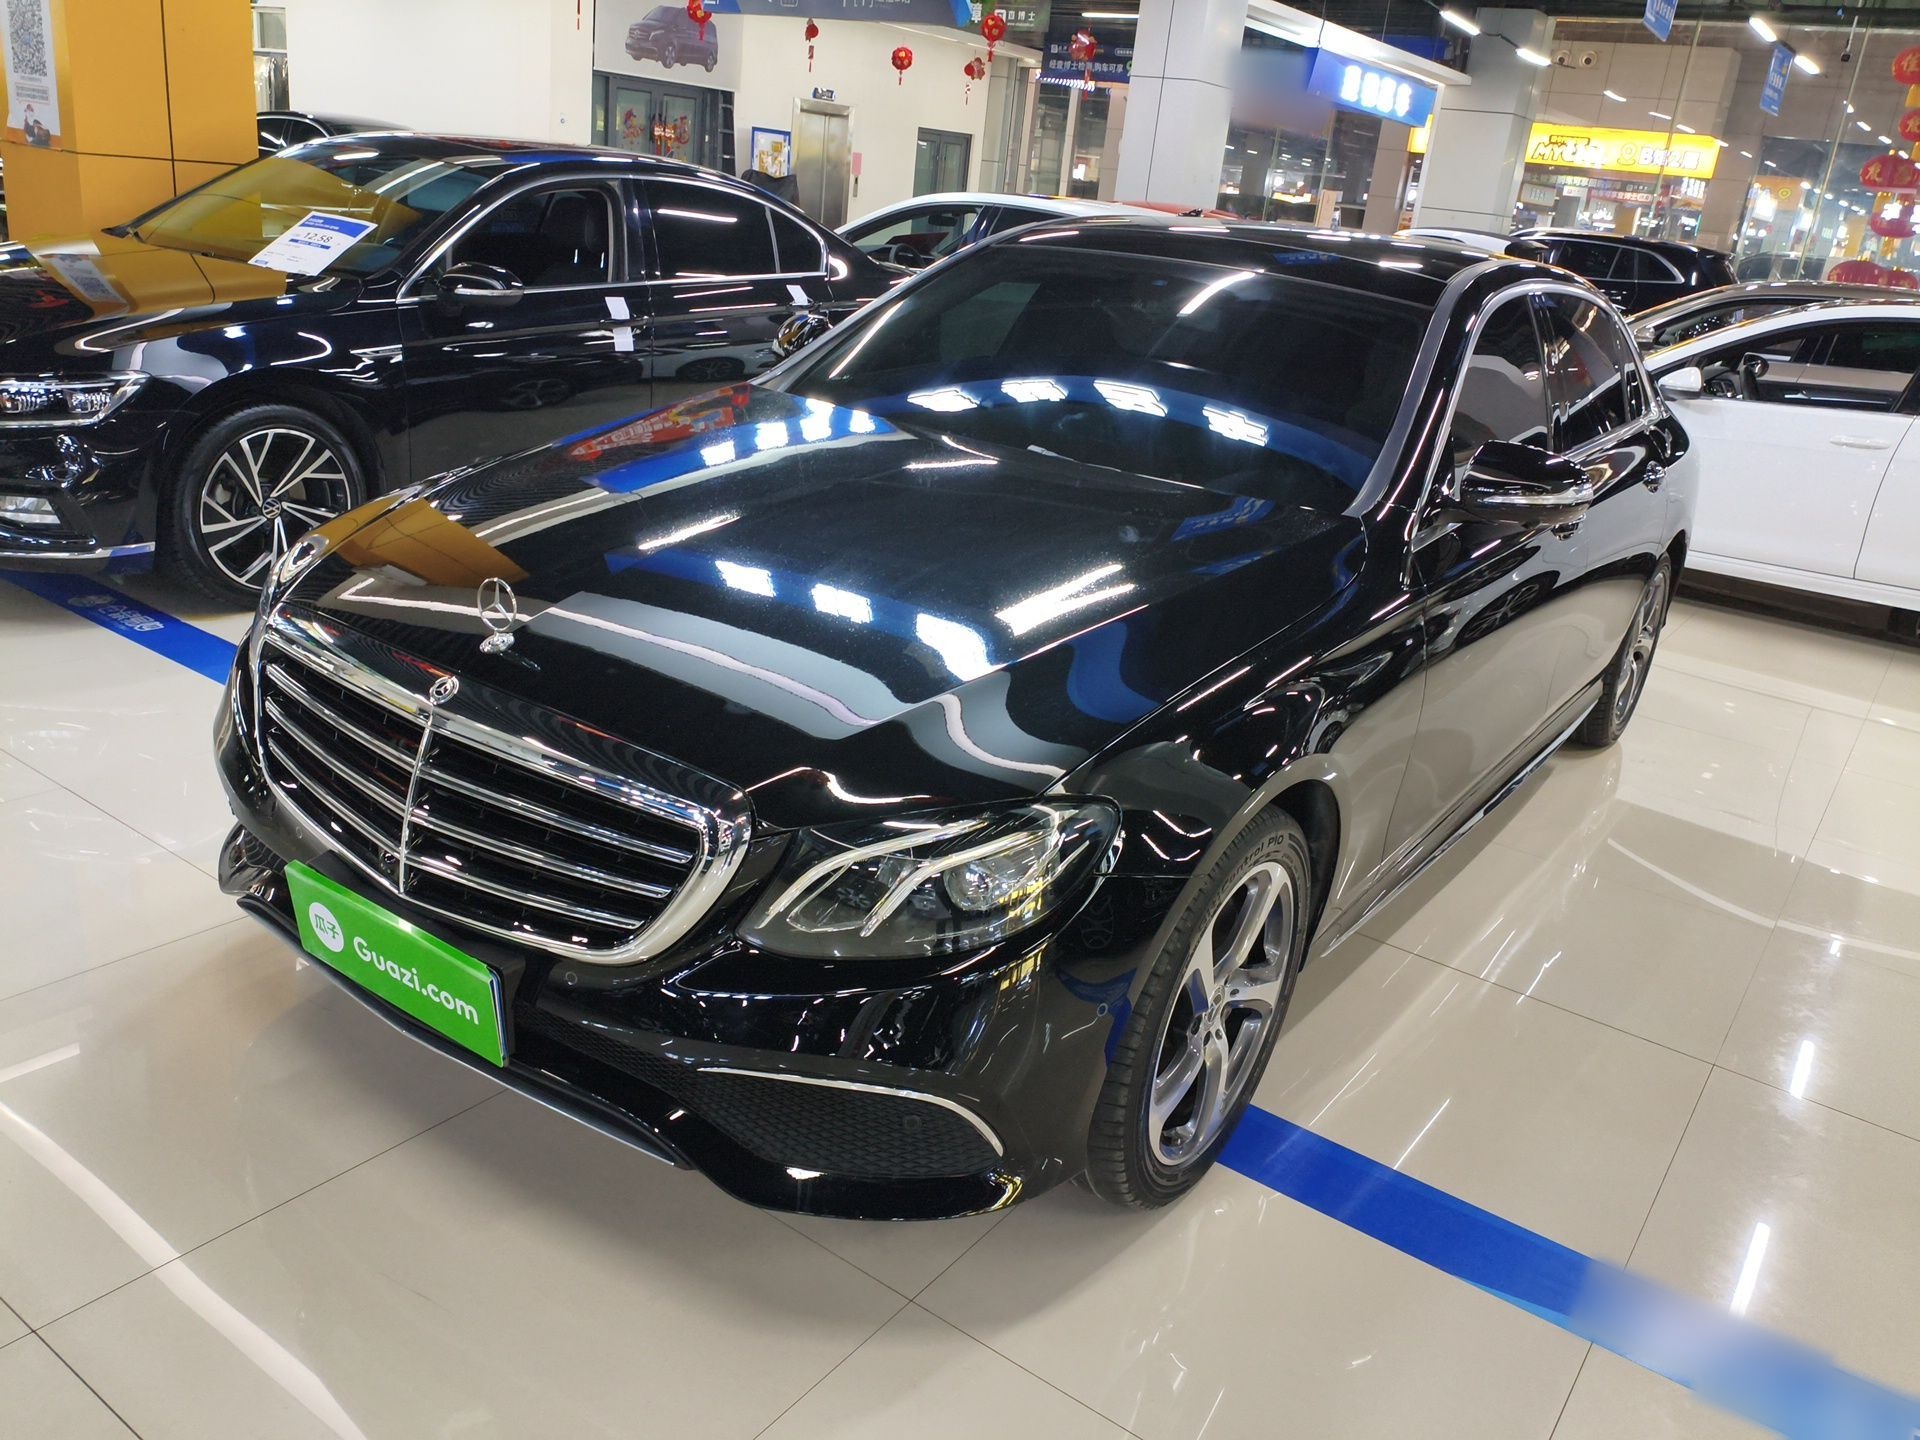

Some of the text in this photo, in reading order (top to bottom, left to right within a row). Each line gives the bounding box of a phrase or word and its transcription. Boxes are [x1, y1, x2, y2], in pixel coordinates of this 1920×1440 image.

[303, 232, 333, 243] 12.58
[314, 913, 341, 940] 瓜子
[353, 936, 480, 1025] Guazi.com
